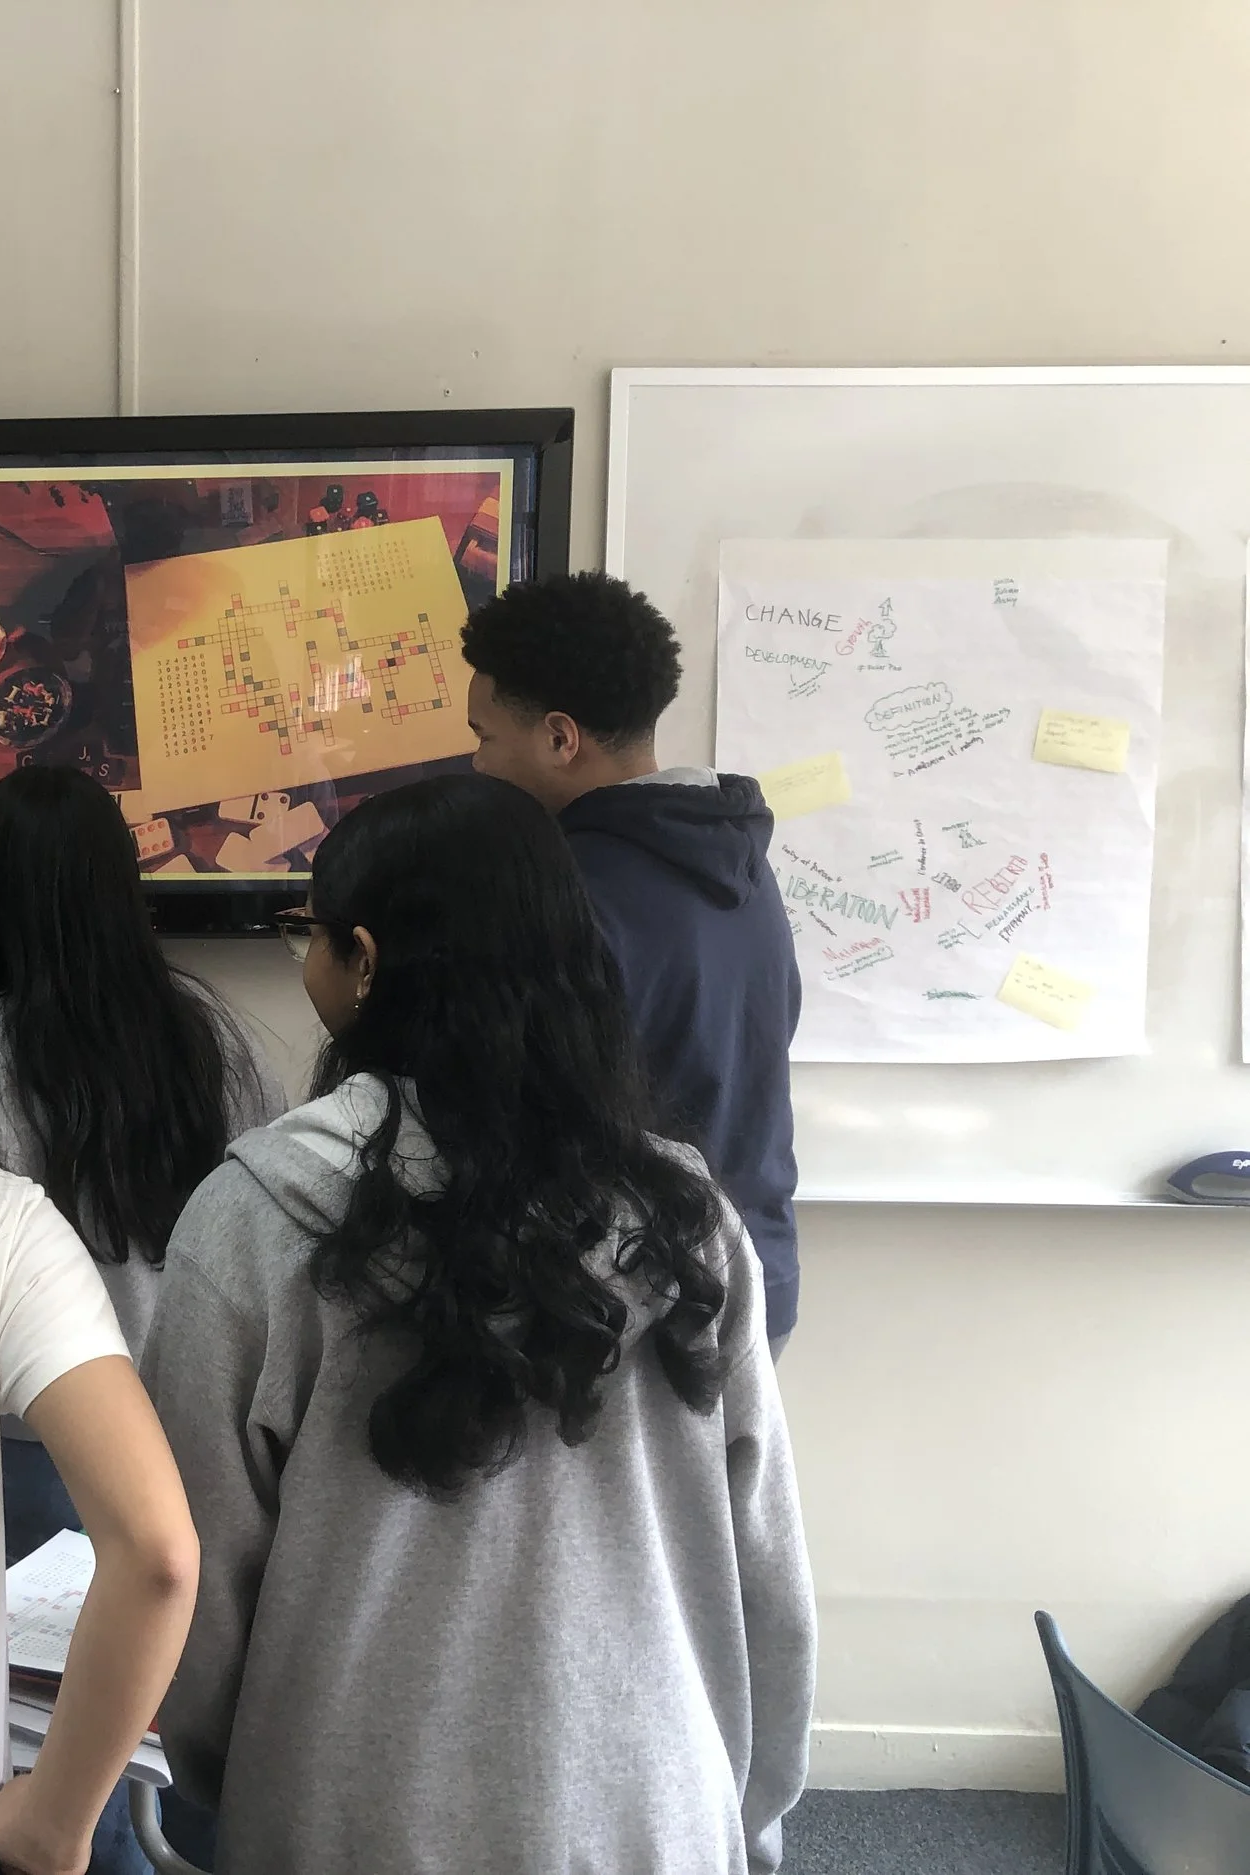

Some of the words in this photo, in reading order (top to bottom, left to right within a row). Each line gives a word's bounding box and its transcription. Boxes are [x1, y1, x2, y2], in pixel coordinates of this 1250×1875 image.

[745, 603, 843, 632] CHANGE
[745, 645, 833, 672] DEVELOPMENT
[874, 692, 942, 722] DEFINITION
[98, 763, 110, 777] S
[961, 854, 1029, 916] REBIRTH
[998, 900, 1034, 944] EPIPHANY
